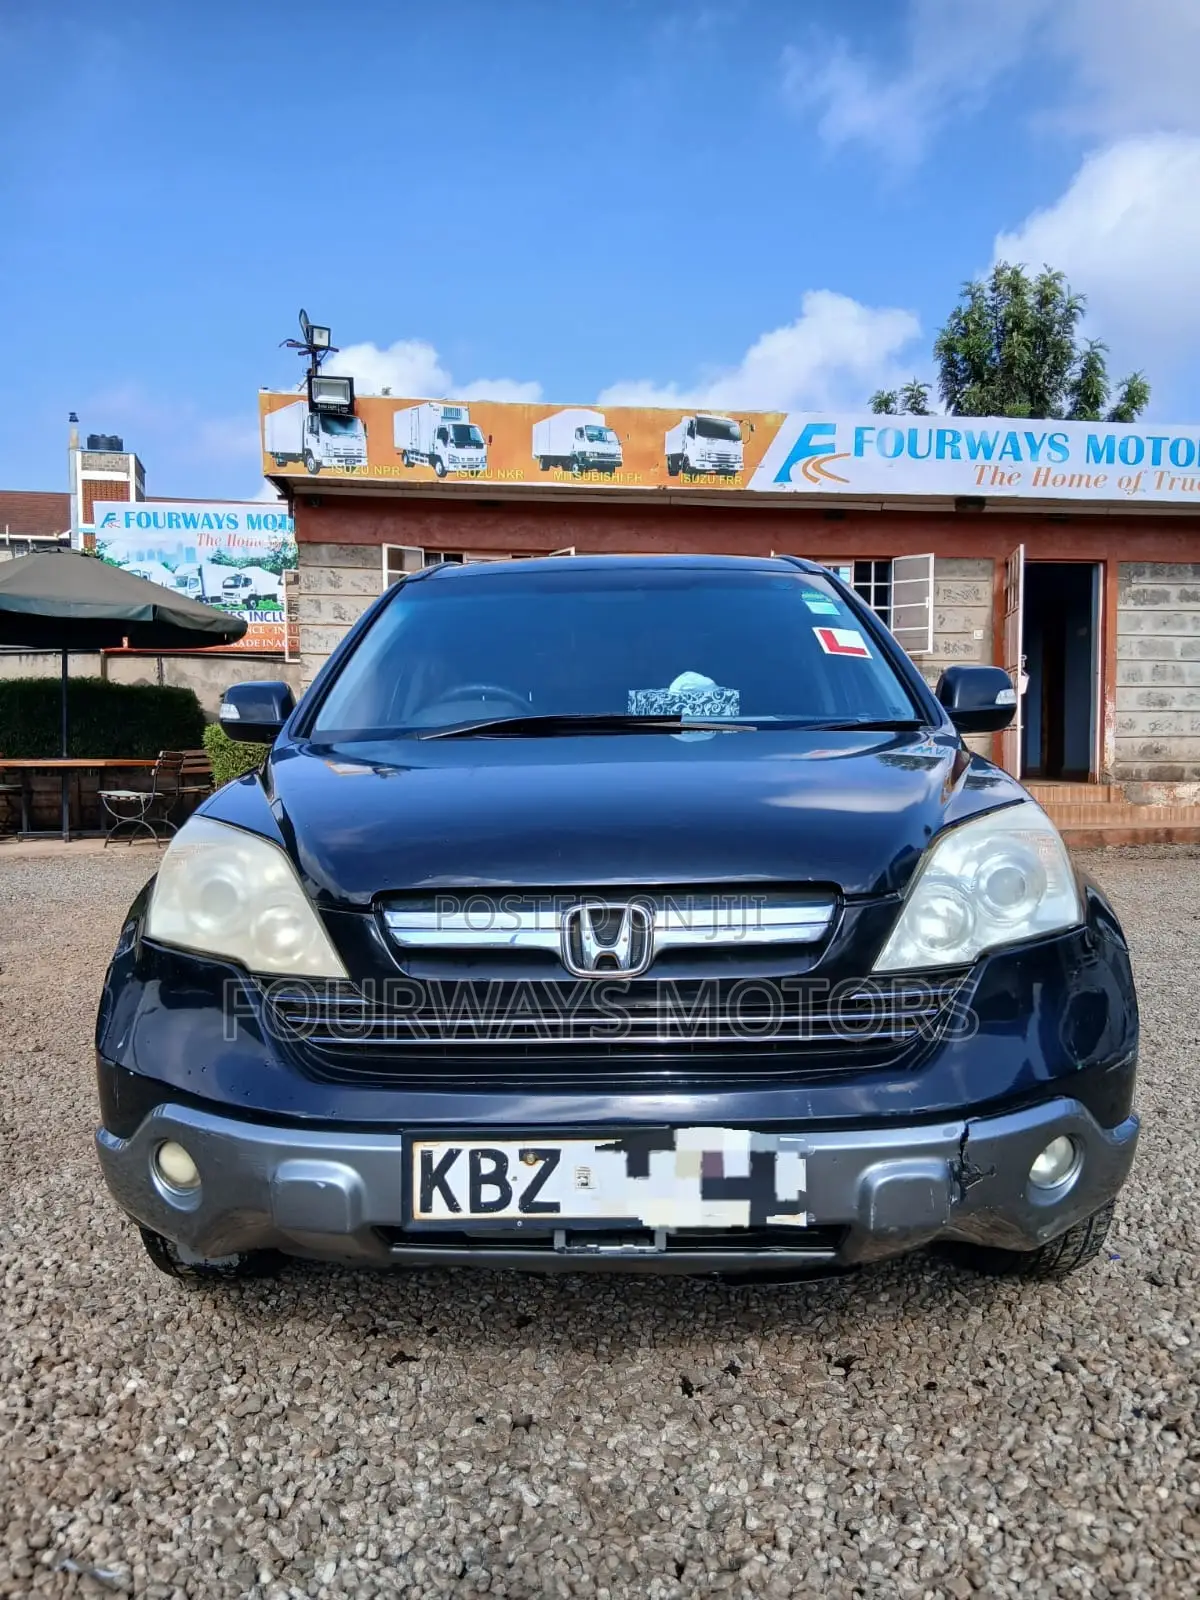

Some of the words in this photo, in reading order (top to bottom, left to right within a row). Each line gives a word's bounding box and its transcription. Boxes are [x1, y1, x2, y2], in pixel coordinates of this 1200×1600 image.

[853, 426, 1070, 463] FOURWAYS
[1086, 434, 1200, 468] MOTO
[374, 465, 400, 476] NPR
[456, 469, 493, 479] ISUZU
[497, 468, 524, 480] NKR
[553, 471, 623, 484] MITSUBISHI
[680, 473, 716, 485] ISUZU
[973, 464, 1022, 487] The
[1032, 467, 1108, 489] Home
[1117, 470, 1147, 495] of
[124, 511, 239, 530] FOURWAYS
[246, 513, 296, 531] MOT
[419, 1148, 562, 1214] KBZ
